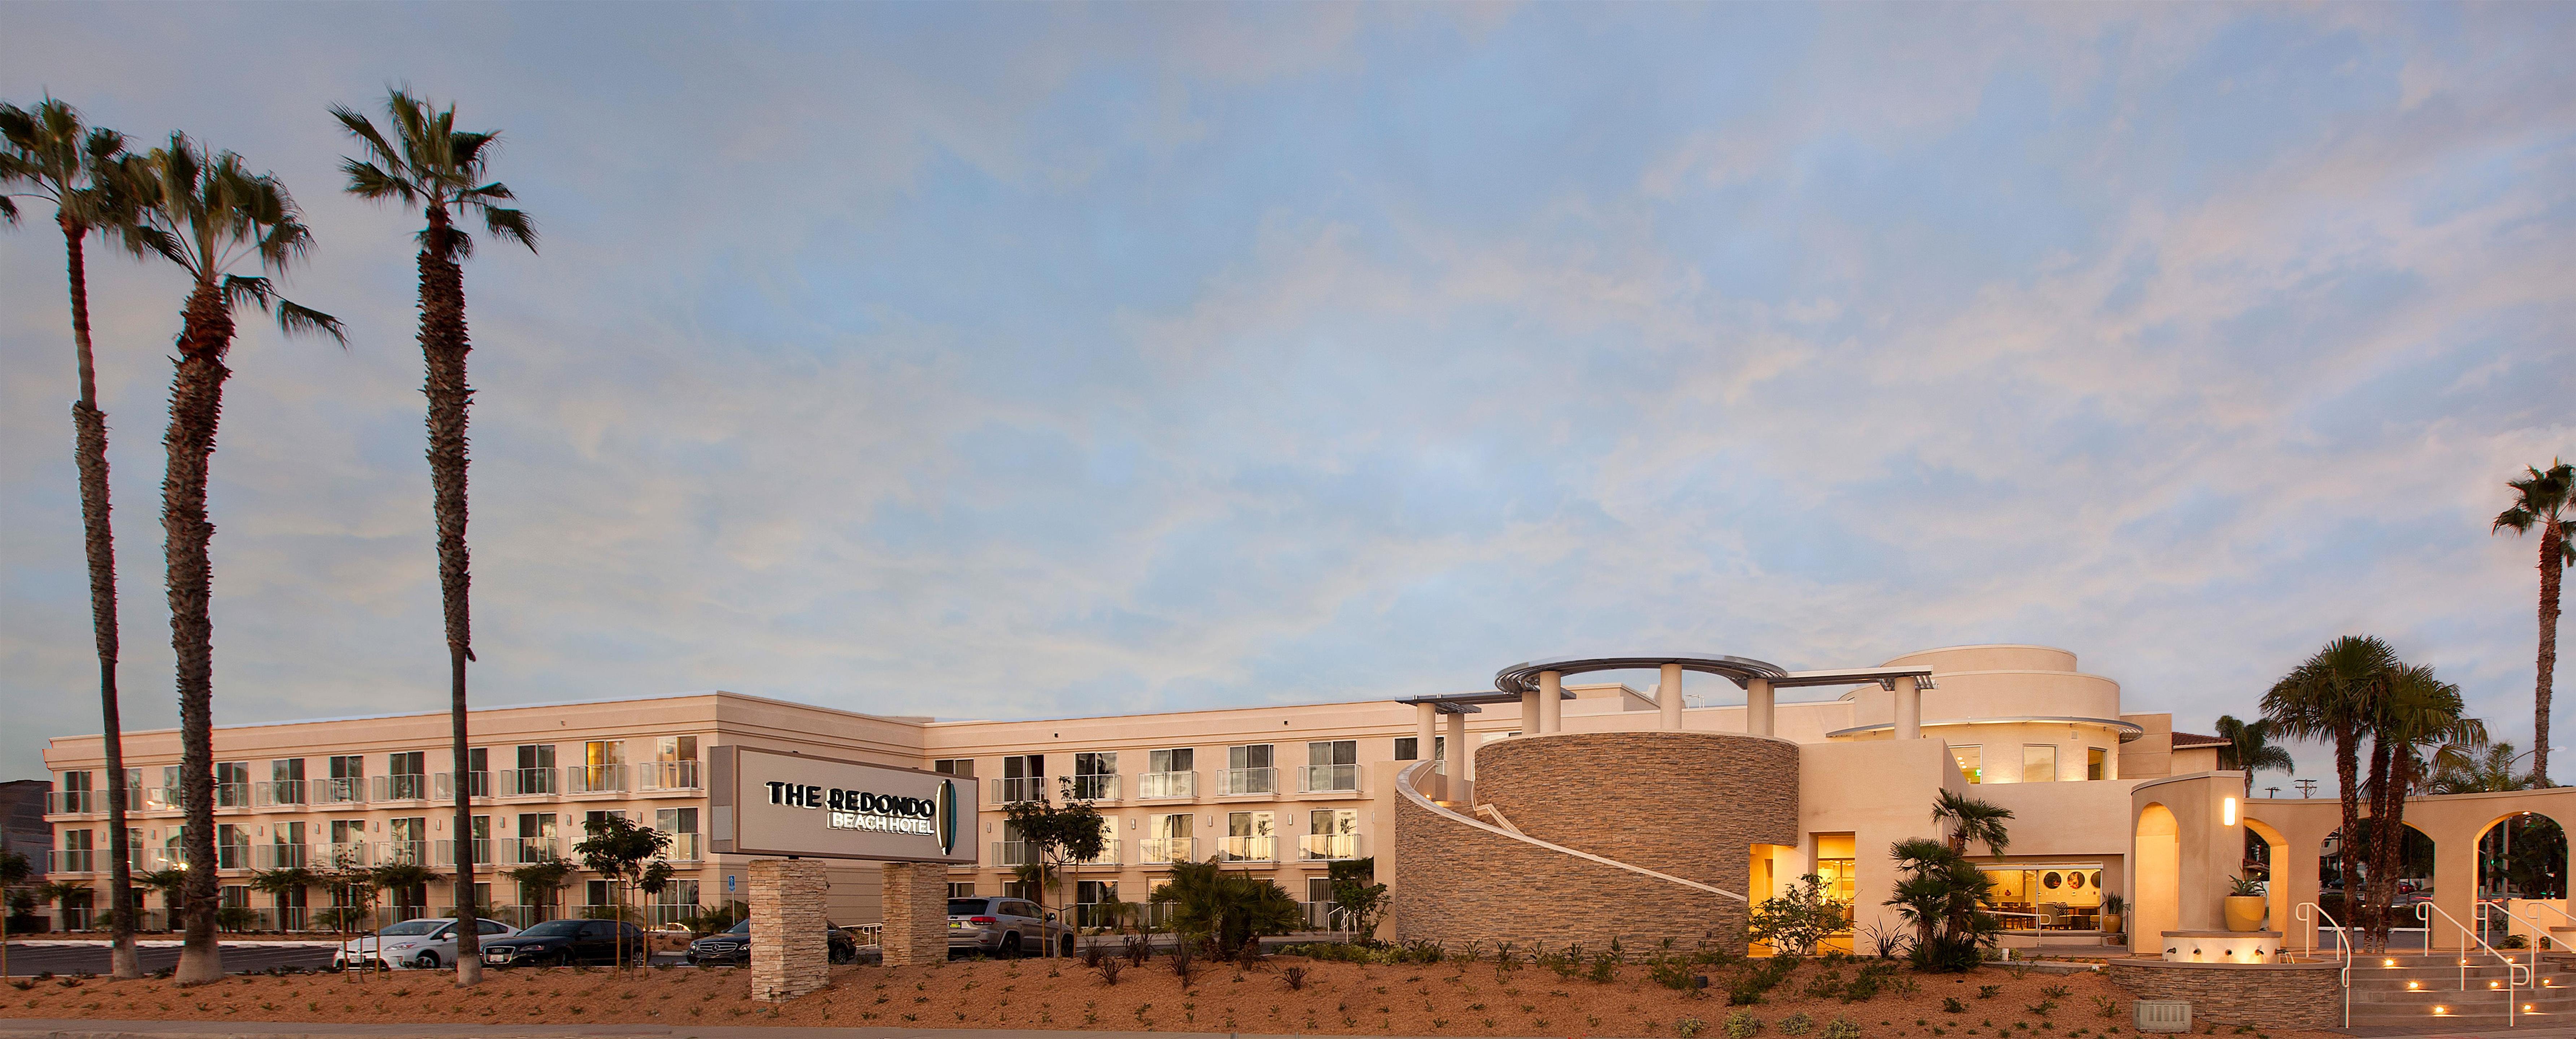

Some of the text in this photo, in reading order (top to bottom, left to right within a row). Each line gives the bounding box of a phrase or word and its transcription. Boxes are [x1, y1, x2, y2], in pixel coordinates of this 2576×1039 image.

[765, 781, 935, 817] THE REDONDO
[832, 812, 935, 834] BEACH HOTEL
